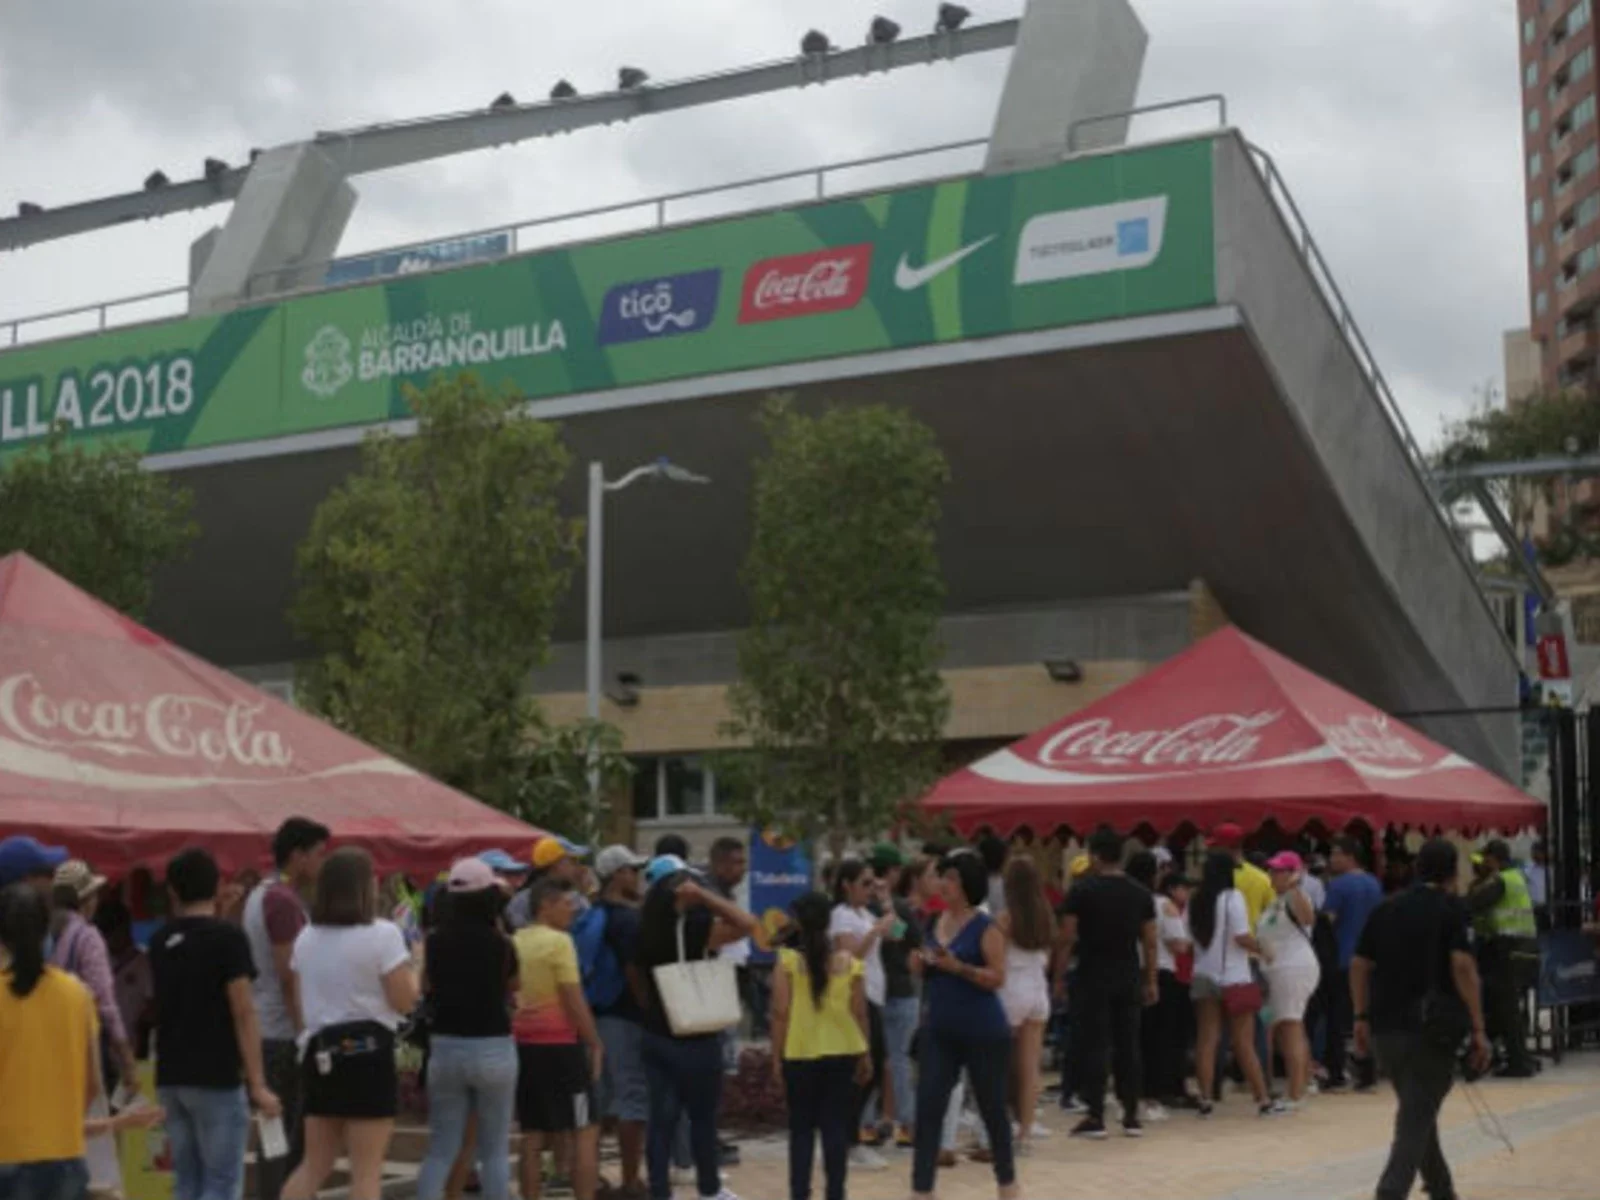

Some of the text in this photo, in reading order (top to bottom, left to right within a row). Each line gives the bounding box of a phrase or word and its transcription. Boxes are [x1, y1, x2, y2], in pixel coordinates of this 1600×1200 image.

[358, 319, 566, 381] BARRANQUILLA
[450, 309, 472, 337] DE
[90, 357, 193, 427] 2018
